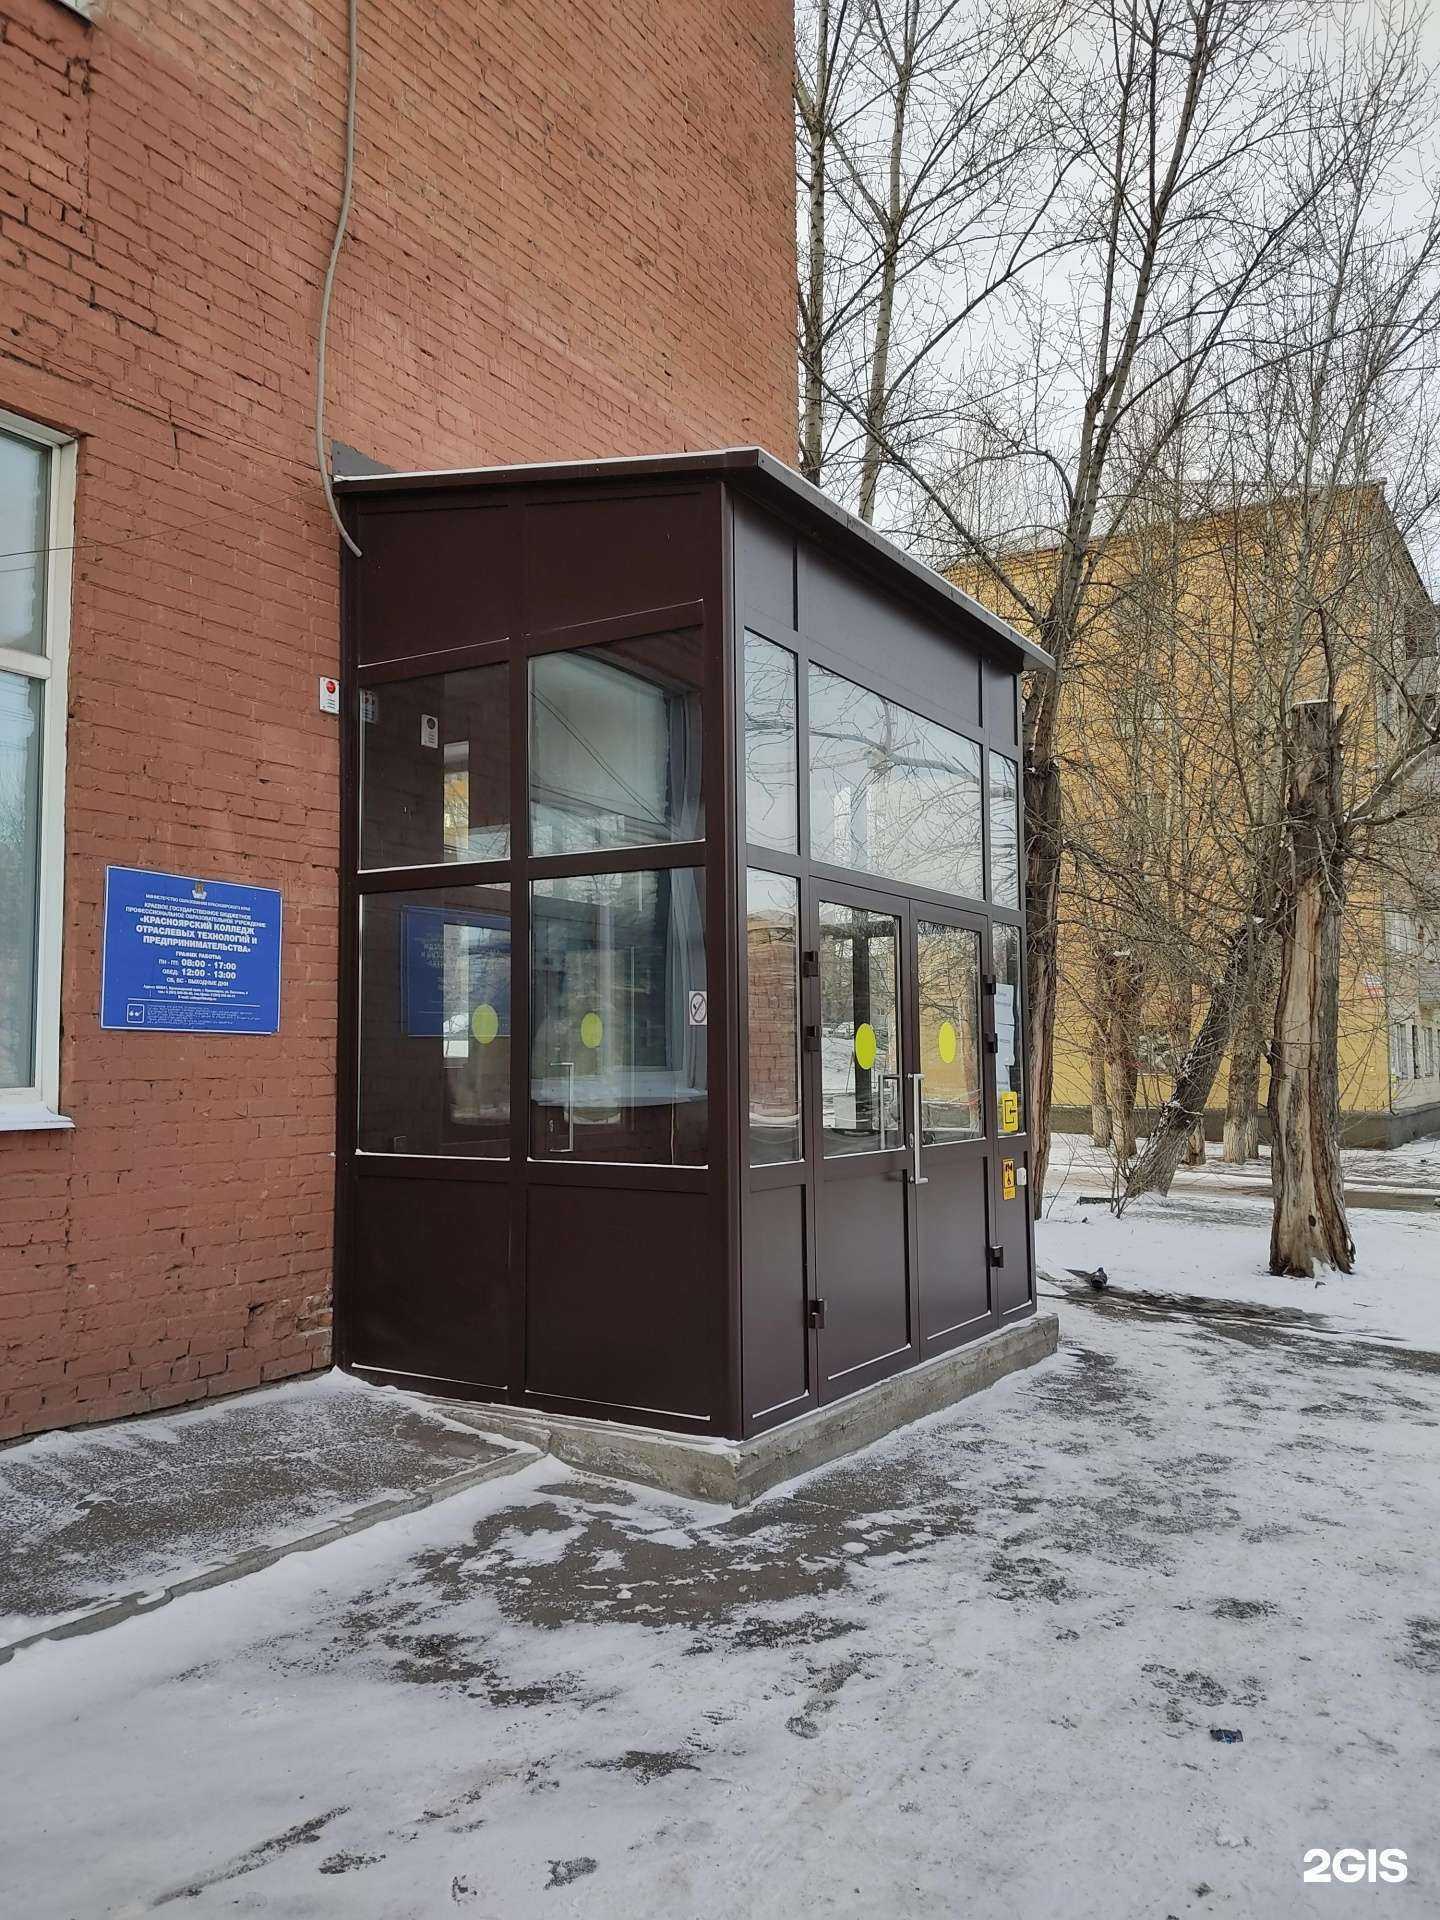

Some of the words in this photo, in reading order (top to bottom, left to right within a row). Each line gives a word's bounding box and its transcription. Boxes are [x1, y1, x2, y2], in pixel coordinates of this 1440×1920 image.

[136, 924, 195, 938] ОТРАСЛЕВЫХ
[196, 931, 250, 944] ТЕХНОЛОГИЙ
[140, 915, 212, 930] «КРАСНОЯРСКИЙ
[214, 923, 255, 935] КОЛЛЕДЖ
[142, 935, 251, 953] ПРЕДПРИНИМАТЕЛЬСТВА»
[181, 958, 206, 968] 08:00
[214, 961, 236, 970] 17:00
[181, 968, 206, 977] 12:00
[214, 970, 236, 979] 13:00
